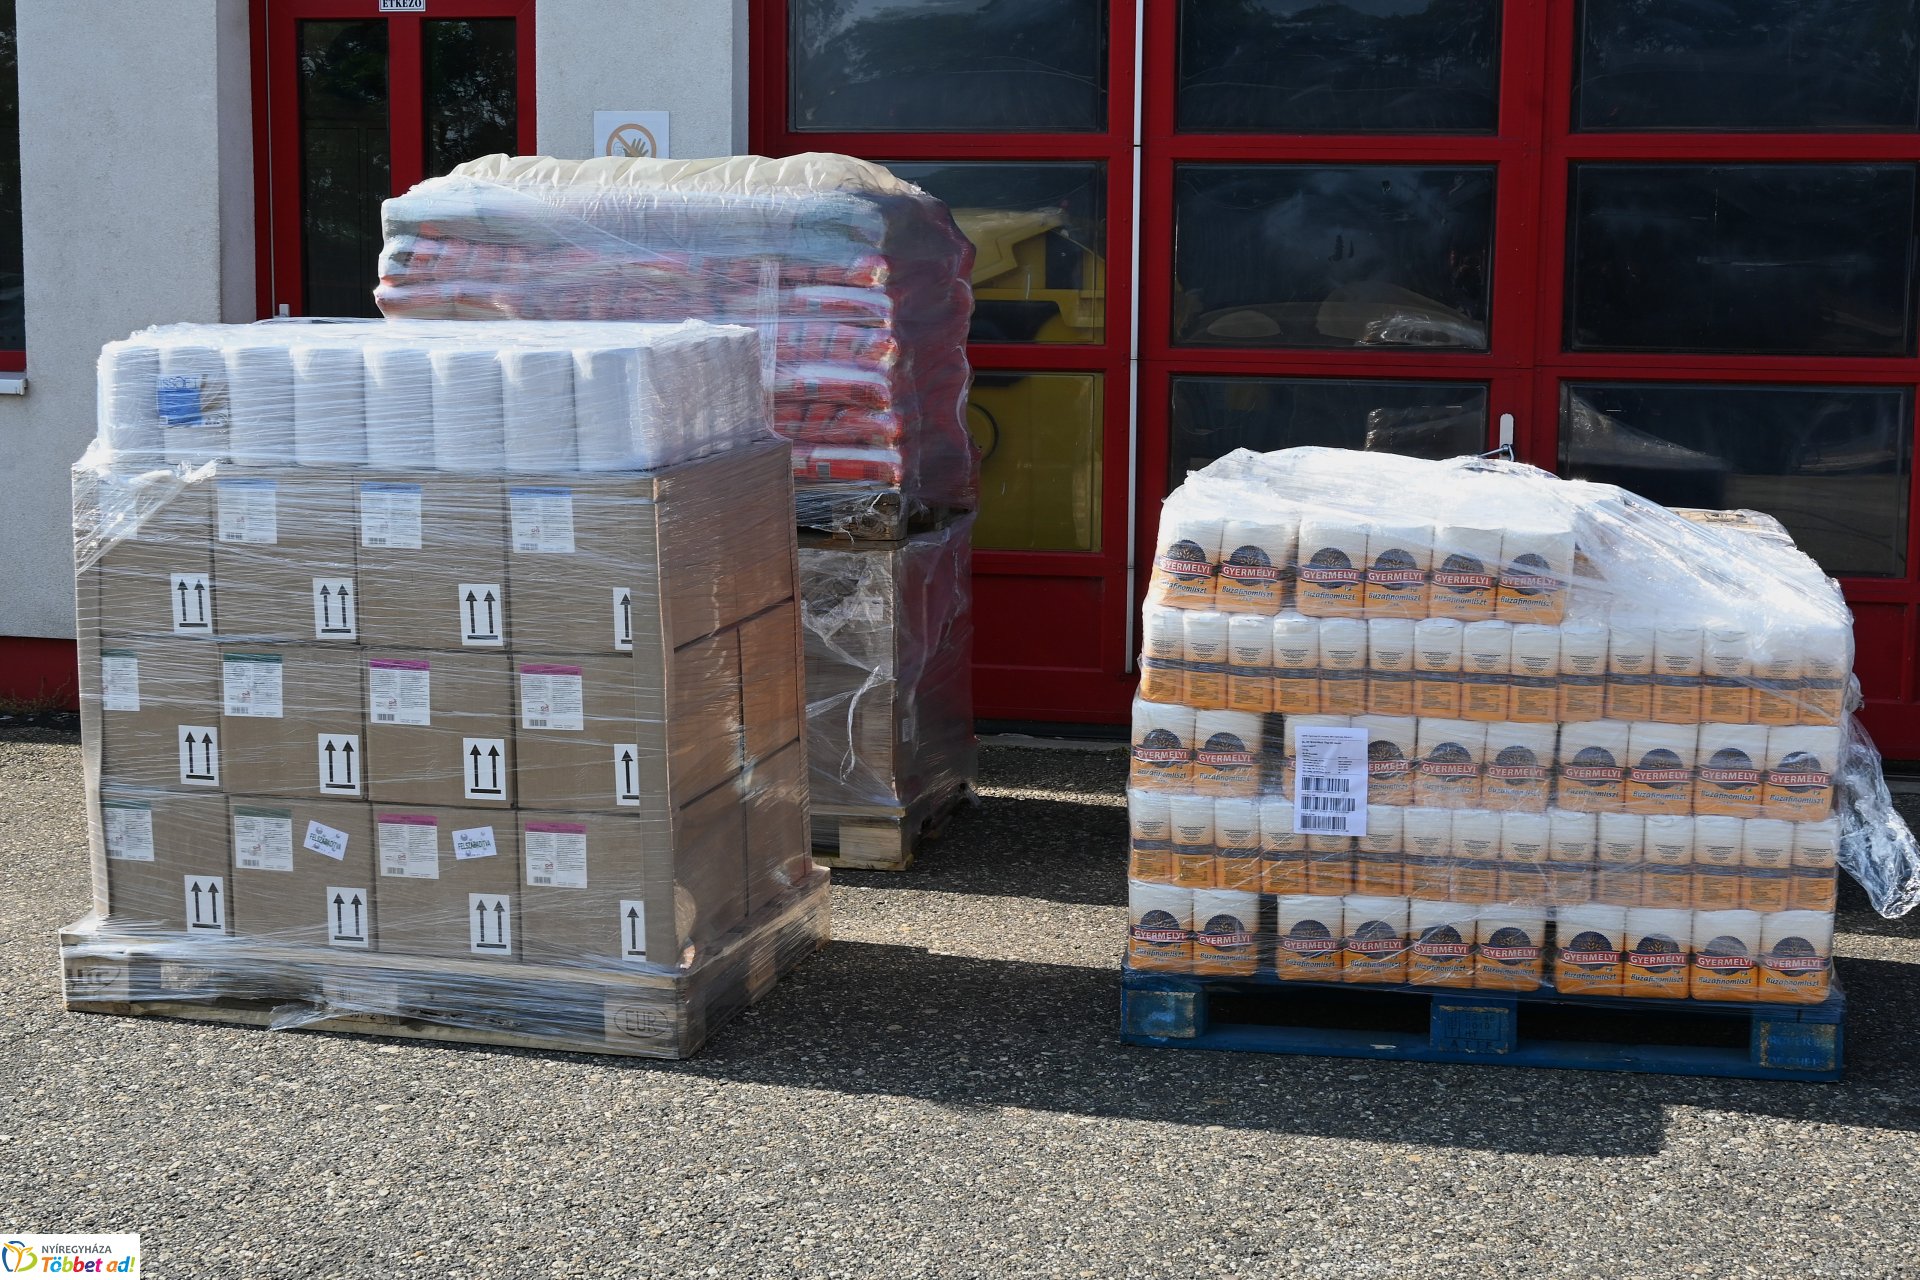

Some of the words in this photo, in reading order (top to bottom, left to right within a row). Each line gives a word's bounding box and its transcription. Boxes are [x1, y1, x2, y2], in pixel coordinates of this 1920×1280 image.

[1223, 566, 1276, 578] GYERMELYI
[1303, 570, 1356, 580] GYERMELYI
[1368, 571, 1422, 581] GYERMELYI
[1434, 574, 1489, 585] GYERMELYI
[1501, 576, 1556, 586] GYERMELYI
[1137, 750, 1187, 760] GYERMELYI
[1199, 754, 1250, 763] GYERMELYI
[1369, 762, 1409, 772] ERMELYI
[1422, 763, 1476, 774] GYERMELYI
[1488, 767, 1543, 777] GYERMELYI
[1566, 768, 1621, 778] GYERMELYI
[1632, 771, 1688, 780] GYERMELYI
[1701, 770, 1757, 781] GYERMELYI
[1770, 774, 1826, 784] GYERMELYI
[1134, 930, 1185, 940] GYERMELYI
[1199, 934, 1250, 944] GYERMELYI
[1284, 940, 1336, 950] GYERMELYI
[1349, 941, 1401, 950] GYERMELYI
[1414, 944, 1467, 954] GYERMELYI
[1483, 948, 1536, 957] GYERMELYI
[1563, 952, 1617, 962] GYERMELYI
[1630, 954, 1685, 964] GYERMELYI
[1698, 957, 1752, 966] GYERMELYI
[1766, 959, 1820, 968] GYERMELYI
